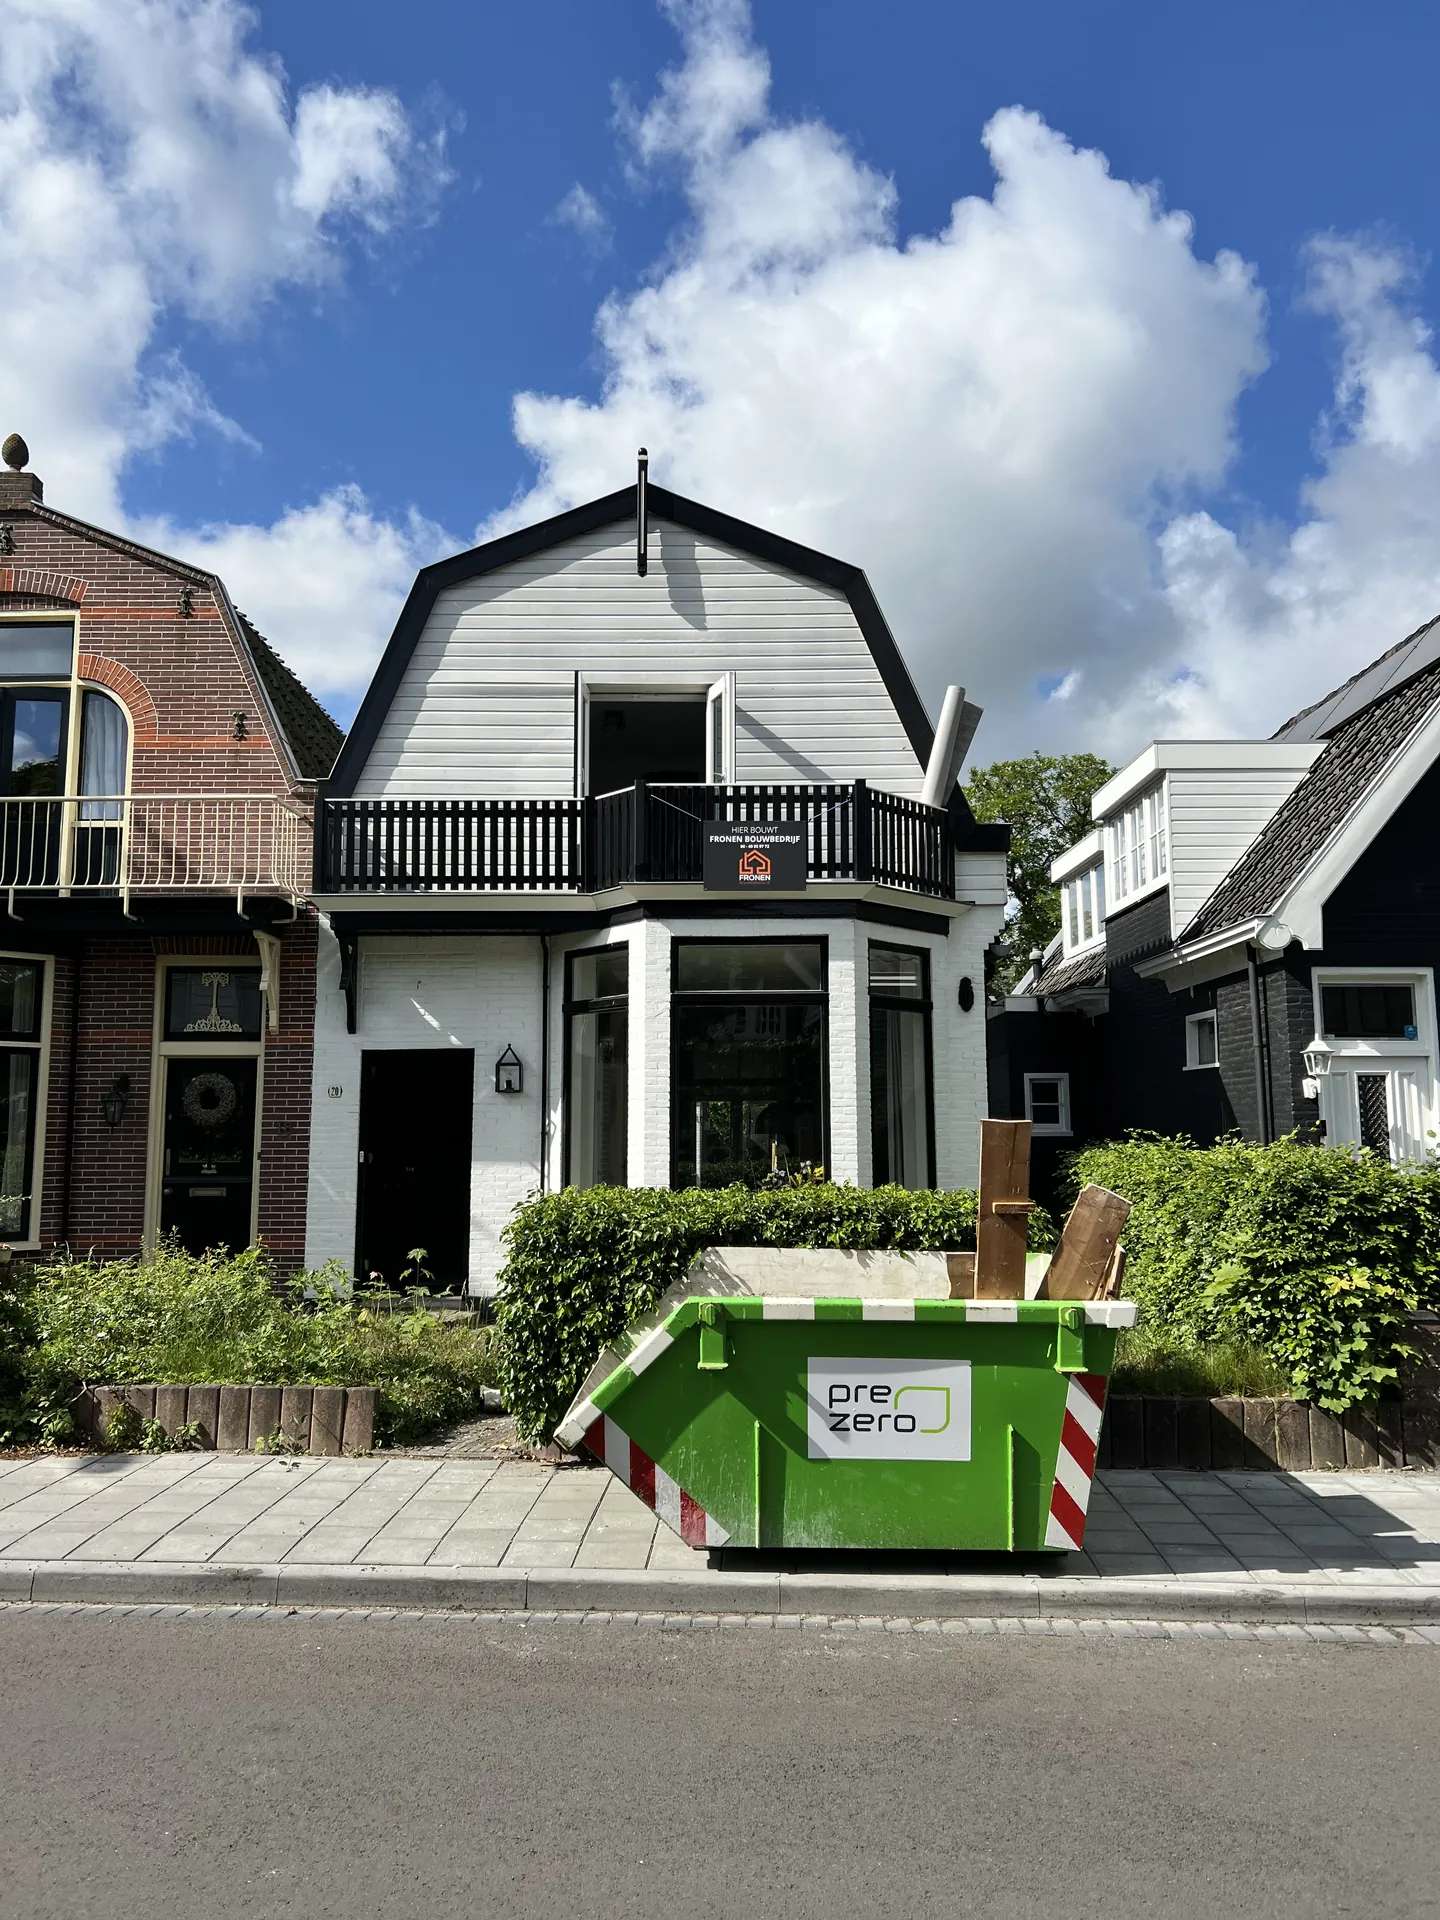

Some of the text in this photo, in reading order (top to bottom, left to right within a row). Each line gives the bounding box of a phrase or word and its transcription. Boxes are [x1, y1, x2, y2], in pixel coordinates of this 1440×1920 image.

[744, 836, 800, 844] BOUWBEDRIJF
[330, 1086, 340, 1096] 20
[828, 1384, 892, 1409] pre
[828, 1413, 916, 1433] zero
